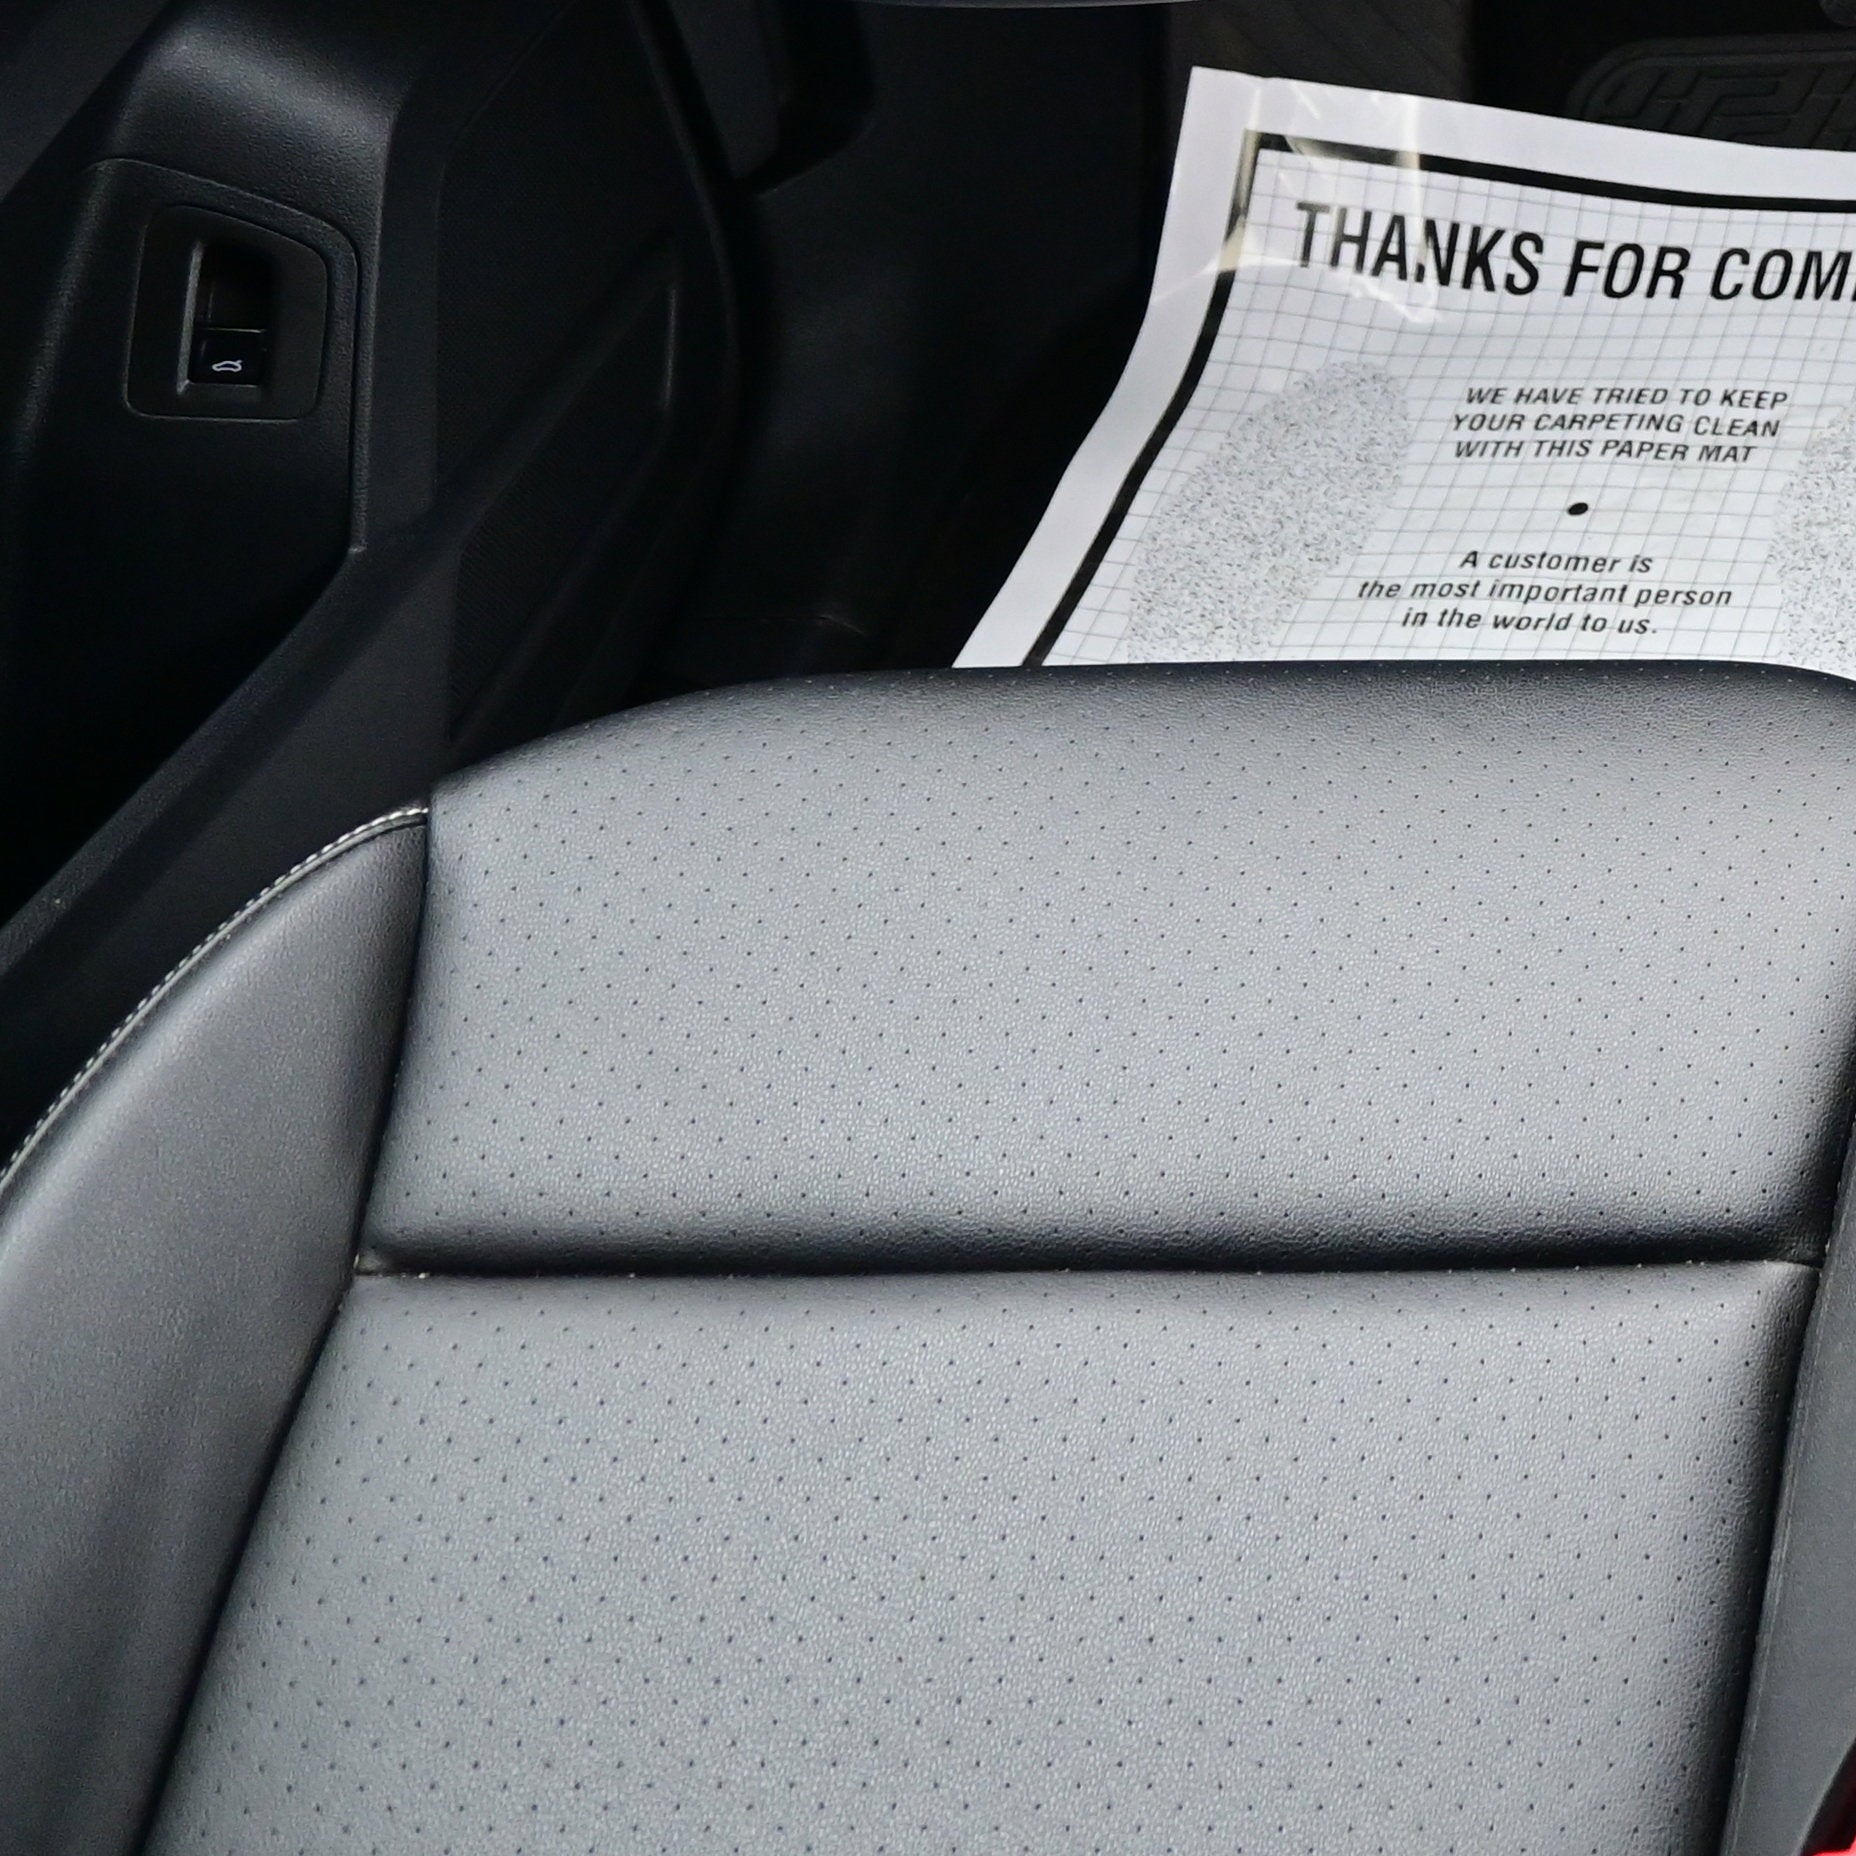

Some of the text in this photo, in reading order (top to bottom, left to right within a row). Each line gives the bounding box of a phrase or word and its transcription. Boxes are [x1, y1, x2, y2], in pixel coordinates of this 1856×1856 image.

[1296, 201, 1544, 296] THANKS
[1564, 239, 1691, 300] FOR
[1466, 387, 1788, 410] WE HAVE TRIED TO KEEP
[1453, 414, 1781, 437] YOUR CARPETING CLEAN
[1454, 440, 1757, 463] WITH THIS PAPER MAT
[1459, 550, 1653, 573] A customer is
[1357, 579, 1732, 608] the most important person
[1401, 607, 1657, 634] in the world to us.
